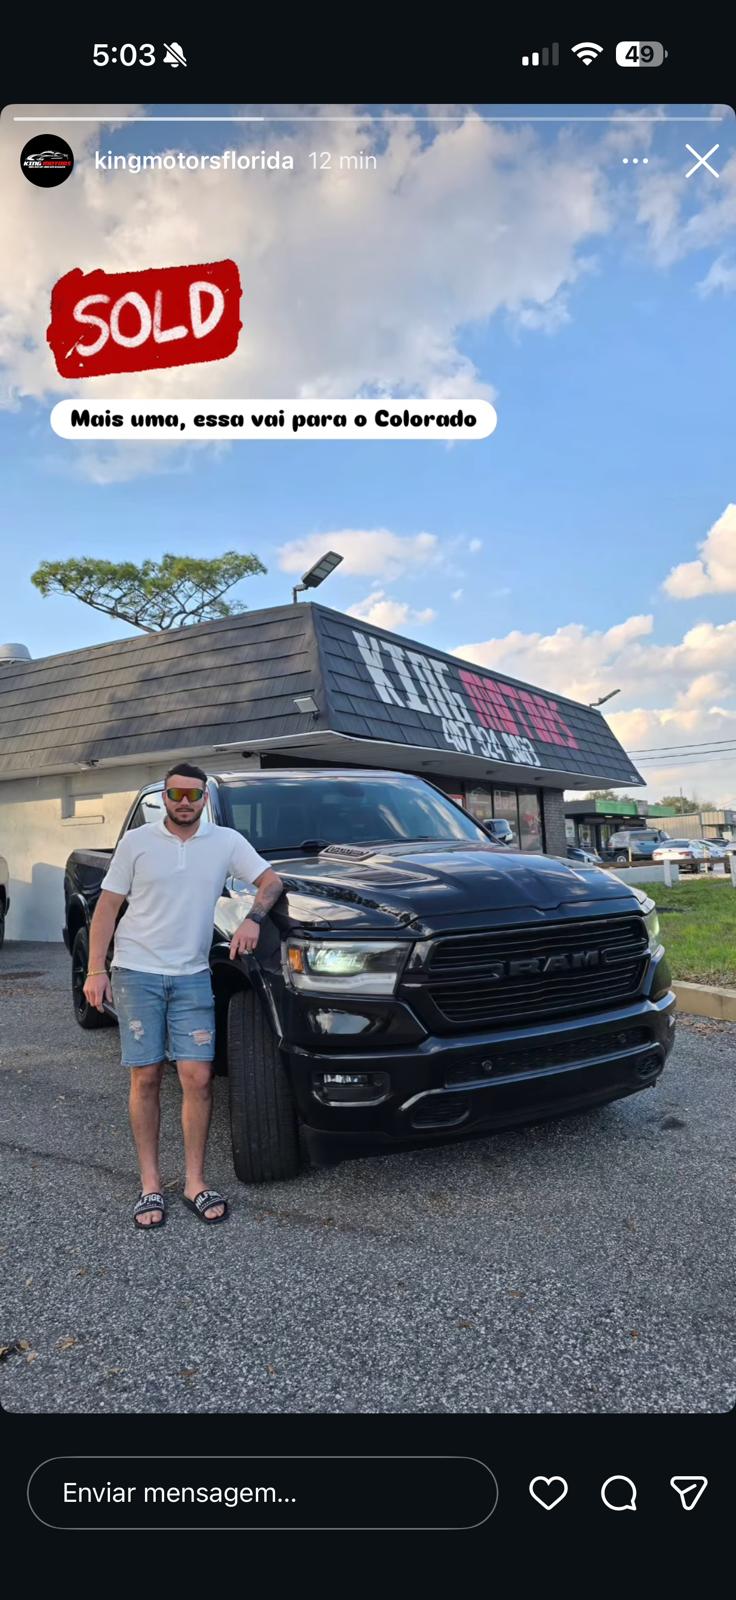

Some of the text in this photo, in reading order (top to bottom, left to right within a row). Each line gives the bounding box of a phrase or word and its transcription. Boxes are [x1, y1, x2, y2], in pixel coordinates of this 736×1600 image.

[351, 630, 579, 749] KING MOTORS
[509, 950, 600, 976] RAM
